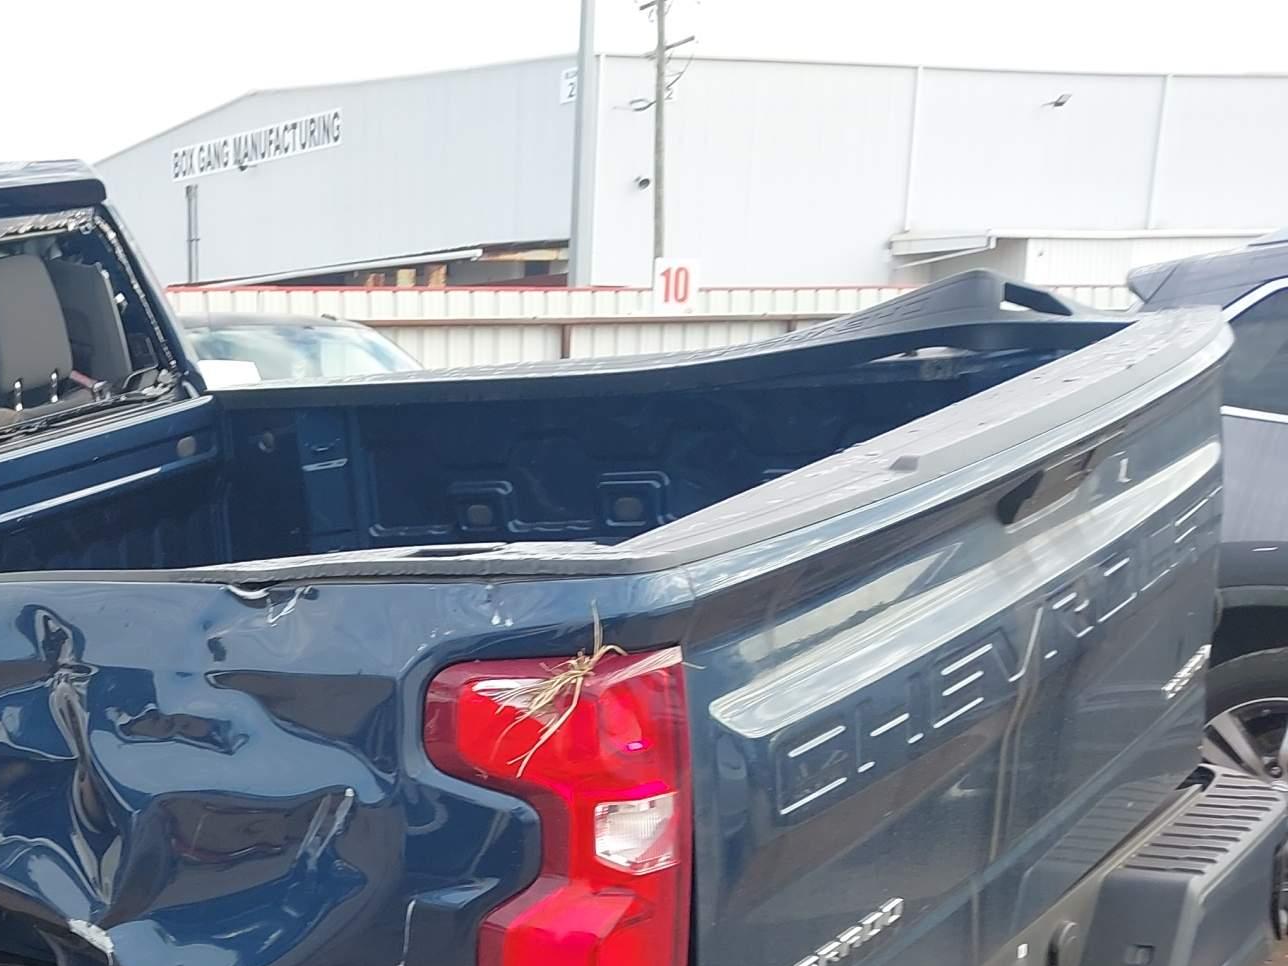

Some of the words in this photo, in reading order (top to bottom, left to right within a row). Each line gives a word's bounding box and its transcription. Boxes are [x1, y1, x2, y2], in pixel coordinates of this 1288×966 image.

[172, 150, 196, 179] BOX
[197, 139, 230, 173] GANG
[232, 111, 342, 166] MANUFACTURING
[660, 266, 689, 303] 10
